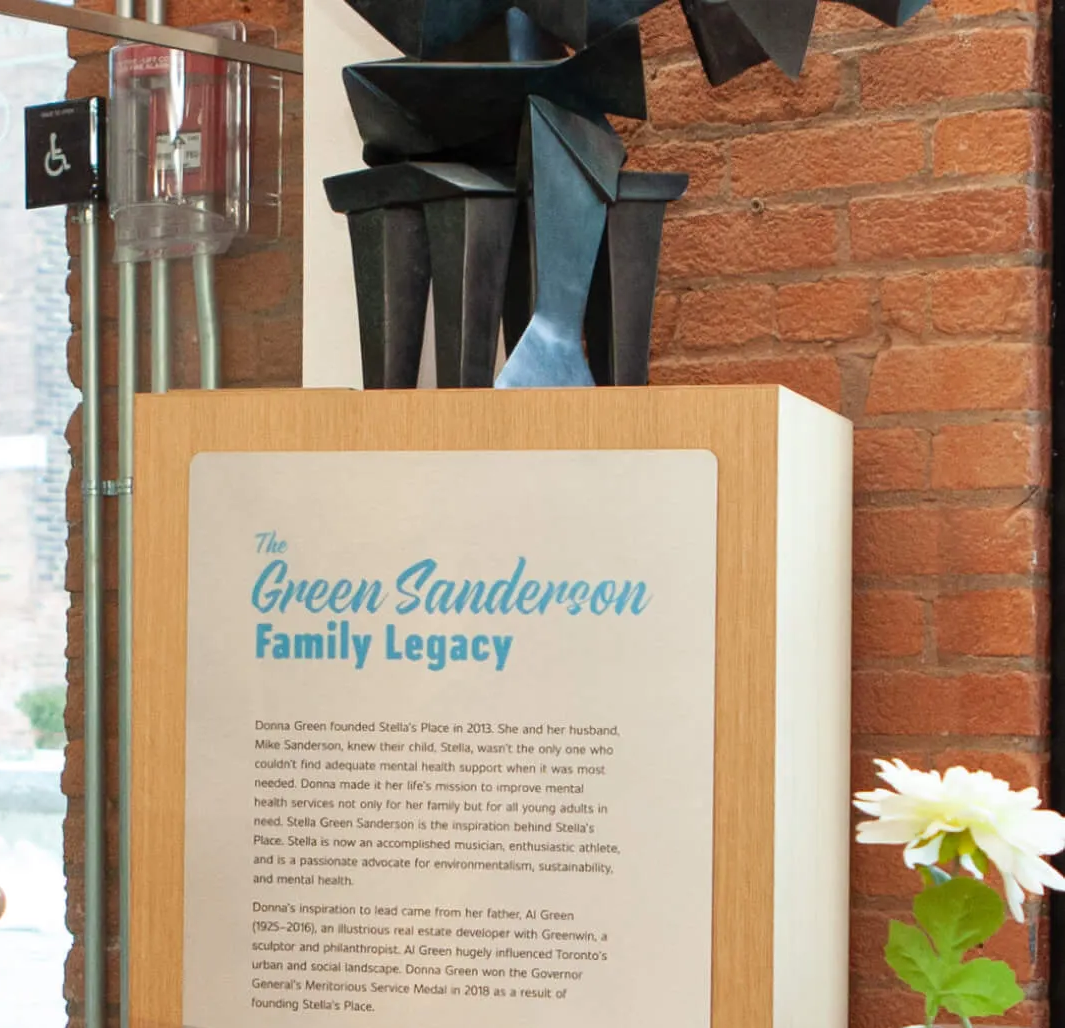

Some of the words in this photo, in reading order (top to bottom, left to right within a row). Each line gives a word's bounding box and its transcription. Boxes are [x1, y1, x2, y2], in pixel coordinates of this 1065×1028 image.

[255, 531, 288, 554] The
[250, 559, 387, 616] Green
[394, 555, 652, 617] Sanderson
[255, 619, 373, 671] Family
[384, 623, 515, 672] Legacy
[255, 720, 290, 731] Donna
[294, 721, 327, 731] Green
[330, 721, 375, 732] founded
[379, 722, 417, 732] Stella's
[421, 722, 449, 733] Place
[453, 724, 463, 733] in
[467, 723, 494, 734] 2013.
[497, 724, 519, 734] She
[523, 724, 543, 735] and
[547, 724, 566, 735] her
[255, 740, 281, 749] Mike
[347, 741, 376, 751] knew
[380, 742, 404, 751] their
[477, 744, 513, 753] wasn't
[517, 744, 534, 754] the
[539, 744, 562, 756] only
[565, 746, 586, 755] one
[590, 745, 613, 755] who
[255, 759, 297, 769] couldn't
[301, 759, 321, 770] find
[325, 760, 376, 772] adequate
[380, 761, 417, 771] mental
[422, 762, 455, 772] health
[459, 764, 502, 775] support
[506, 764, 536, 773] when
[540, 764, 547, 773] it
[551, 766, 573, 774] was
[577, 766, 605, 775] most
[255, 778, 296, 788] needed.
[301, 778, 336, 789] Donna
[339, 780, 370, 790] made
[374, 780, 381, 790] it
[385, 780, 403, 790] her
[407, 780, 431, 791] life's
[435, 784, 477, 792] mission
[481, 784, 492, 792] to
[497, 785, 541, 794] improve
[545, 784, 584, 793] mental
[254, 797, 287, 807] health
[291, 800, 334, 808] services
[338, 800, 355, 808] not
[360, 800, 382, 811] only
[386, 800, 401, 809] for
[406, 800, 423, 810] her
[427, 800, 460, 814] family
[464, 801, 482, 811] but
[487, 801, 502, 812] for
[506, 802, 518, 812] all
[522, 804, 556, 816] young
[560, 803, 594, 814] adults
[598, 804, 607, 813] in
[254, 816, 283, 826] need.
[287, 816, 316, 827] Stella
[320, 817, 353, 828] Green
[357, 818, 414, 829] Sanderson
[418, 820, 427, 830] is
[431, 820, 448, 830] the
[452, 822, 510, 832] inspiration
[514, 822, 551, 832] behind
[556, 822, 594, 833] Stella's
[254, 835, 284, 845] Place.
[288, 836, 317, 847] Stella
[320, 837, 330, 846] is
[333, 839, 356, 847] now
[359, 840, 373, 848] an
[376, 840, 450, 850] accomplished
[509, 841, 574, 852] enthusiastic
[254, 855, 273, 864] and
[277, 856, 286, 865] is
[290, 857, 296, 865] a
[300, 857, 358, 867] passionate
[362, 858, 410, 868] advocate
[415, 858, 430, 869] for
[253, 874, 273, 884] and
[277, 875, 314, 885] mental
[318, 875, 353, 886] health.
[253, 901, 295, 913] Donna's
[300, 904, 355, 915] inspiration
[360, 906, 371, 915] to
[375, 905, 398, 916] lead
[401, 908, 431, 917] came
[435, 907, 461, 917] from
[465, 908, 483, 919] her
[525, 909, 536, 919] Al
[540, 910, 574, 920] Green
[321, 925, 334, 933] an
[338, 924, 390, 935] illustrious
[394, 926, 414, 935] real
[418, 928, 452, 936] estate
[456, 928, 510, 940] developer
[514, 928, 538, 939] with
[252, 941, 296, 952] sculptor
[299, 942, 319, 952] and
[323, 943, 401, 955] philanthropist.
[404, 945, 415, 955] Al
[419, 945, 452, 956] Green
[456, 947, 492, 960] hugely
[496, 948, 553, 959] influenced
[555, 949, 607, 960] Toronto's
[252, 960, 283, 970] urban
[287, 960, 307, 971] and
[311, 962, 341, 972] social
[345, 962, 401, 975] landscape.
[406, 964, 441, 975] Donna
[445, 965, 478, 976] Green
[482, 969, 505, 977] won
[509, 968, 527, 978] the
[531, 968, 583, 980] Governor
[252, 978, 301, 990] General's
[305, 980, 367, 992] Meritorious
[370, 982, 410, 993] Service
[414, 984, 447, 994] Medal
[451, 987, 460, 995] in
[464, 985, 490, 996] 2018
[494, 988, 506, 996] as
[510, 989, 516, 997] a
[520, 988, 551, 998] result
[556, 989, 567, 999] of
[252, 997, 299, 1011] founding
[303, 999, 340, 1010] Stella's
[344, 1000, 375, 1012] Place.
